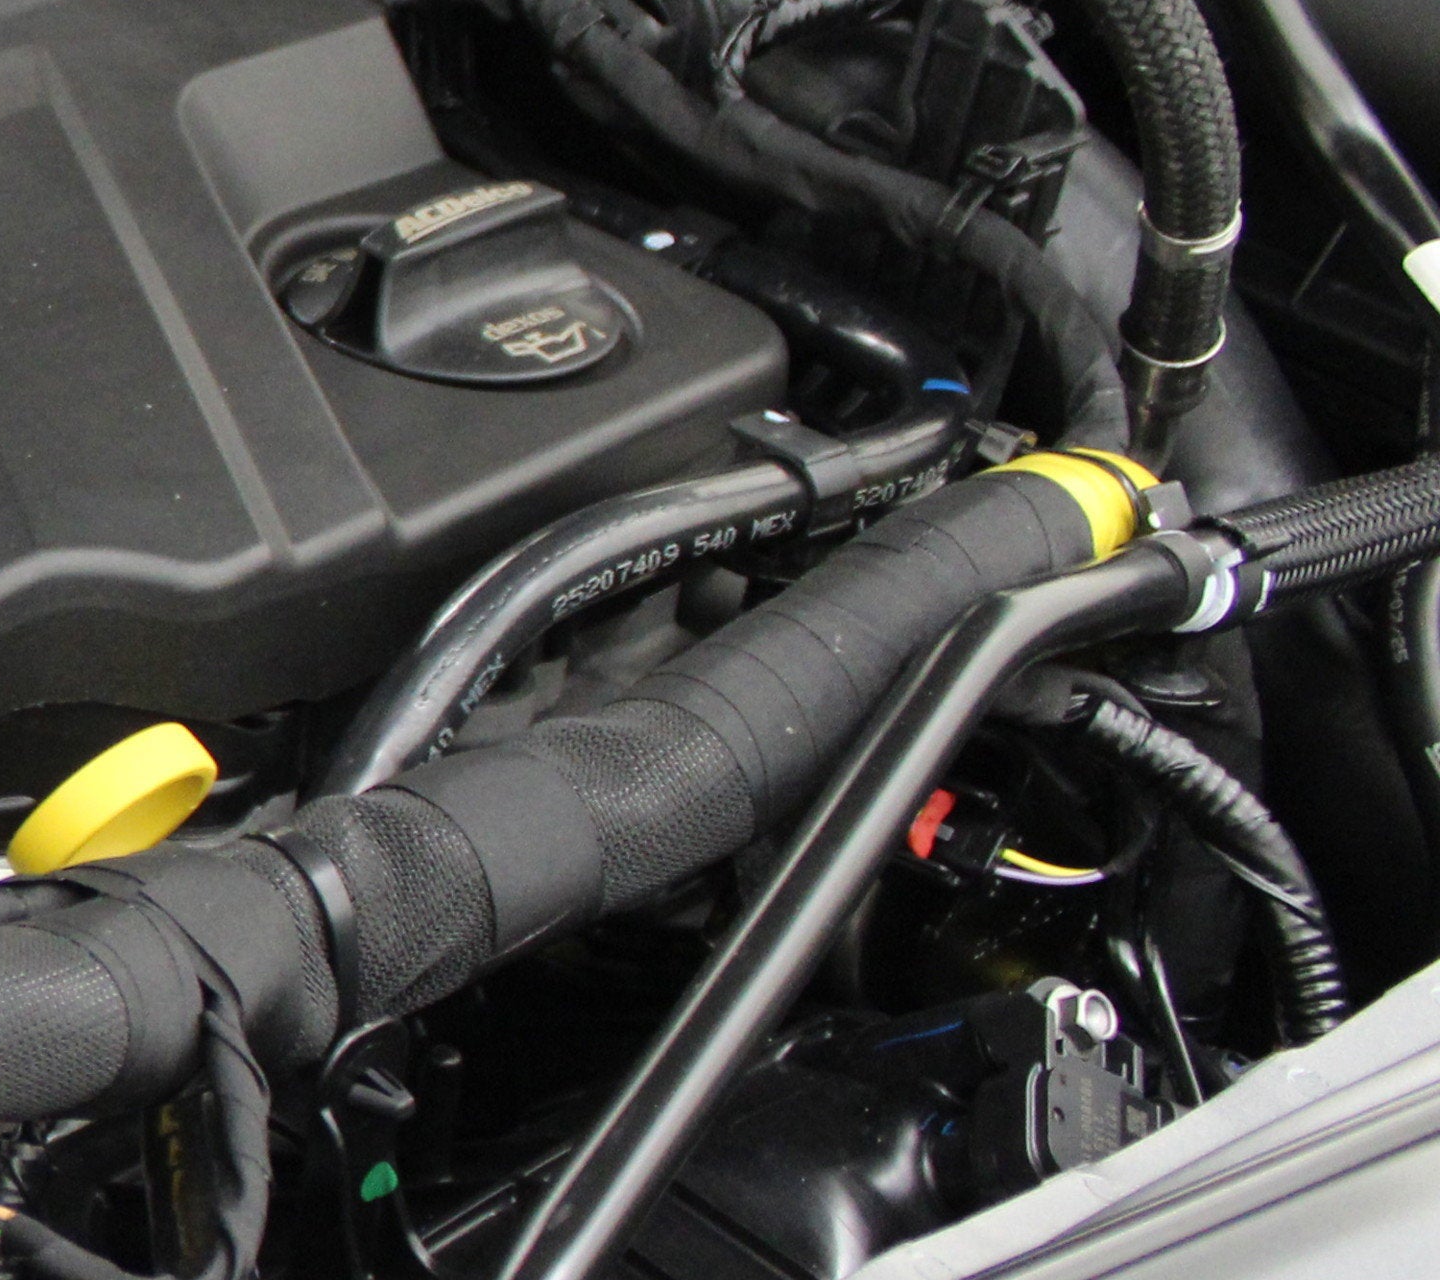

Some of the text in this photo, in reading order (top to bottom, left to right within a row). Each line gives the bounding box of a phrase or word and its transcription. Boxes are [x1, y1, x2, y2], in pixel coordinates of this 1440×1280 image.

[551, 511, 796, 620] 25207409 540 MEX
